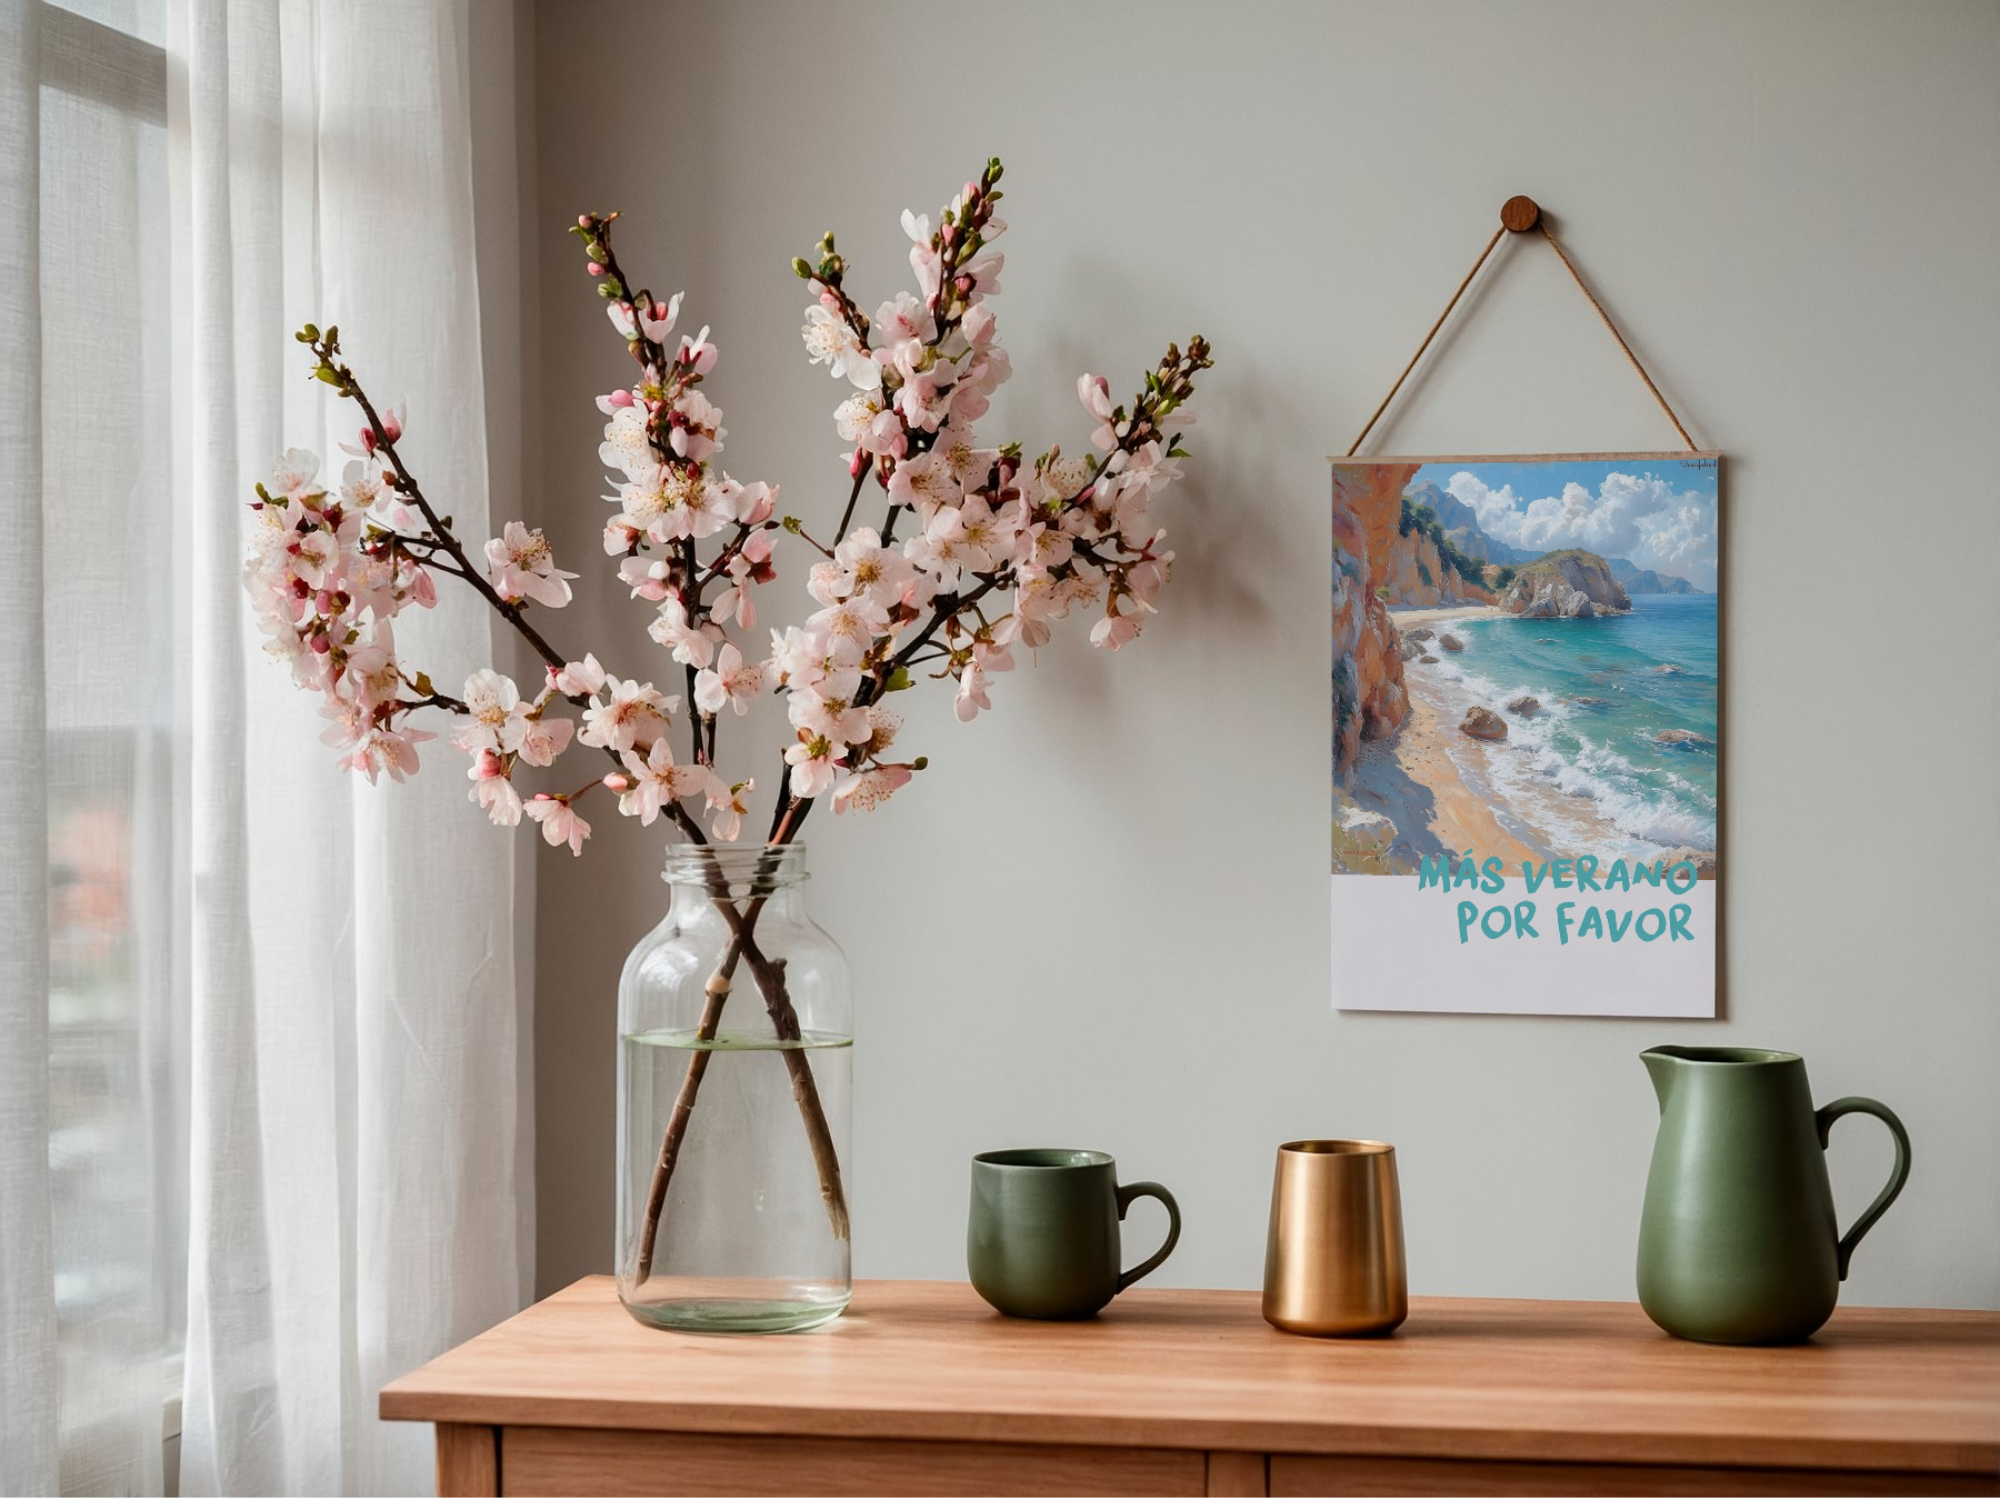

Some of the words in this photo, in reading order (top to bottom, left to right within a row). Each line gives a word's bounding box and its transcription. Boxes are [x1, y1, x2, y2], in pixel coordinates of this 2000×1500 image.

[1418, 850, 1505, 894] MÁS
[1522, 855, 1698, 895] VERANO
[1457, 901, 1540, 944] POR
[1556, 902, 1695, 945] FAVOR
